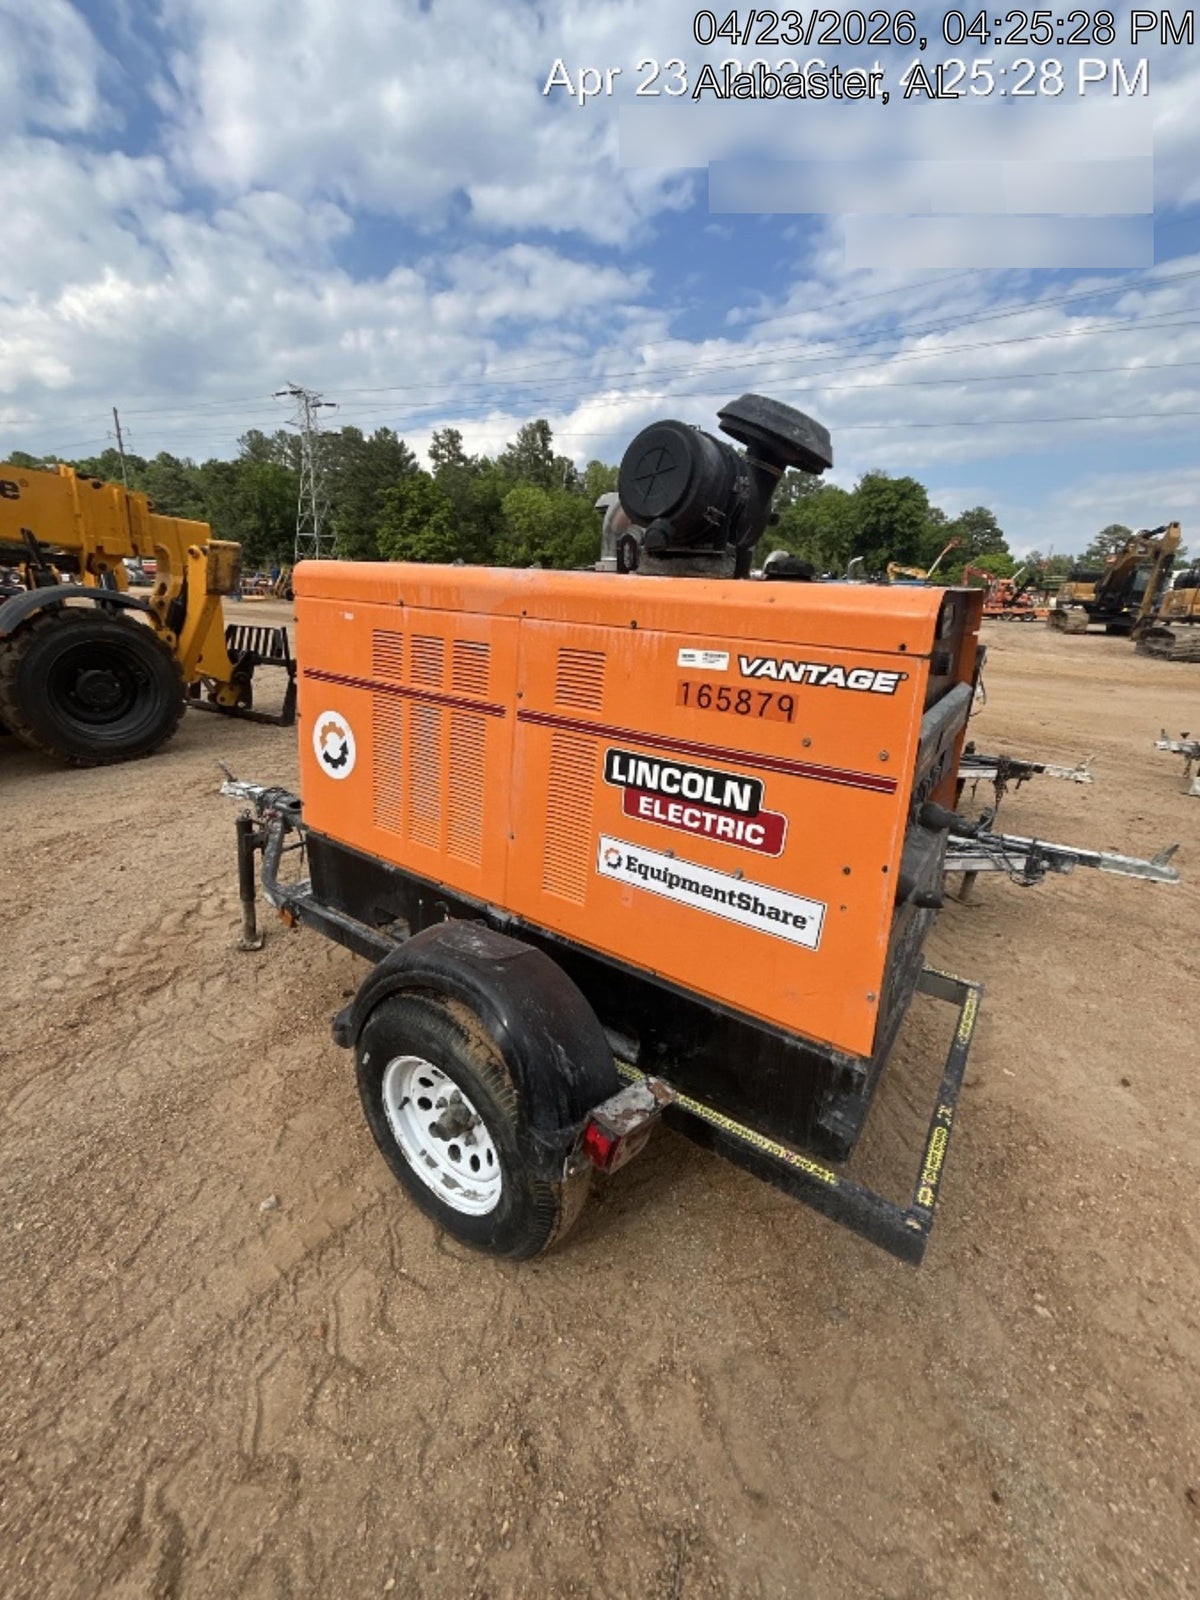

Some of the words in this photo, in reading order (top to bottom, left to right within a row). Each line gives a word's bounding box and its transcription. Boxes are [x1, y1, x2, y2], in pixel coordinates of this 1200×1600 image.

[680, 682, 796, 723] 165879
[610, 754, 752, 812] LINCOLN
[637, 796, 767, 847] ELECTRIC
[624, 854, 809, 931] EquipmentShare
